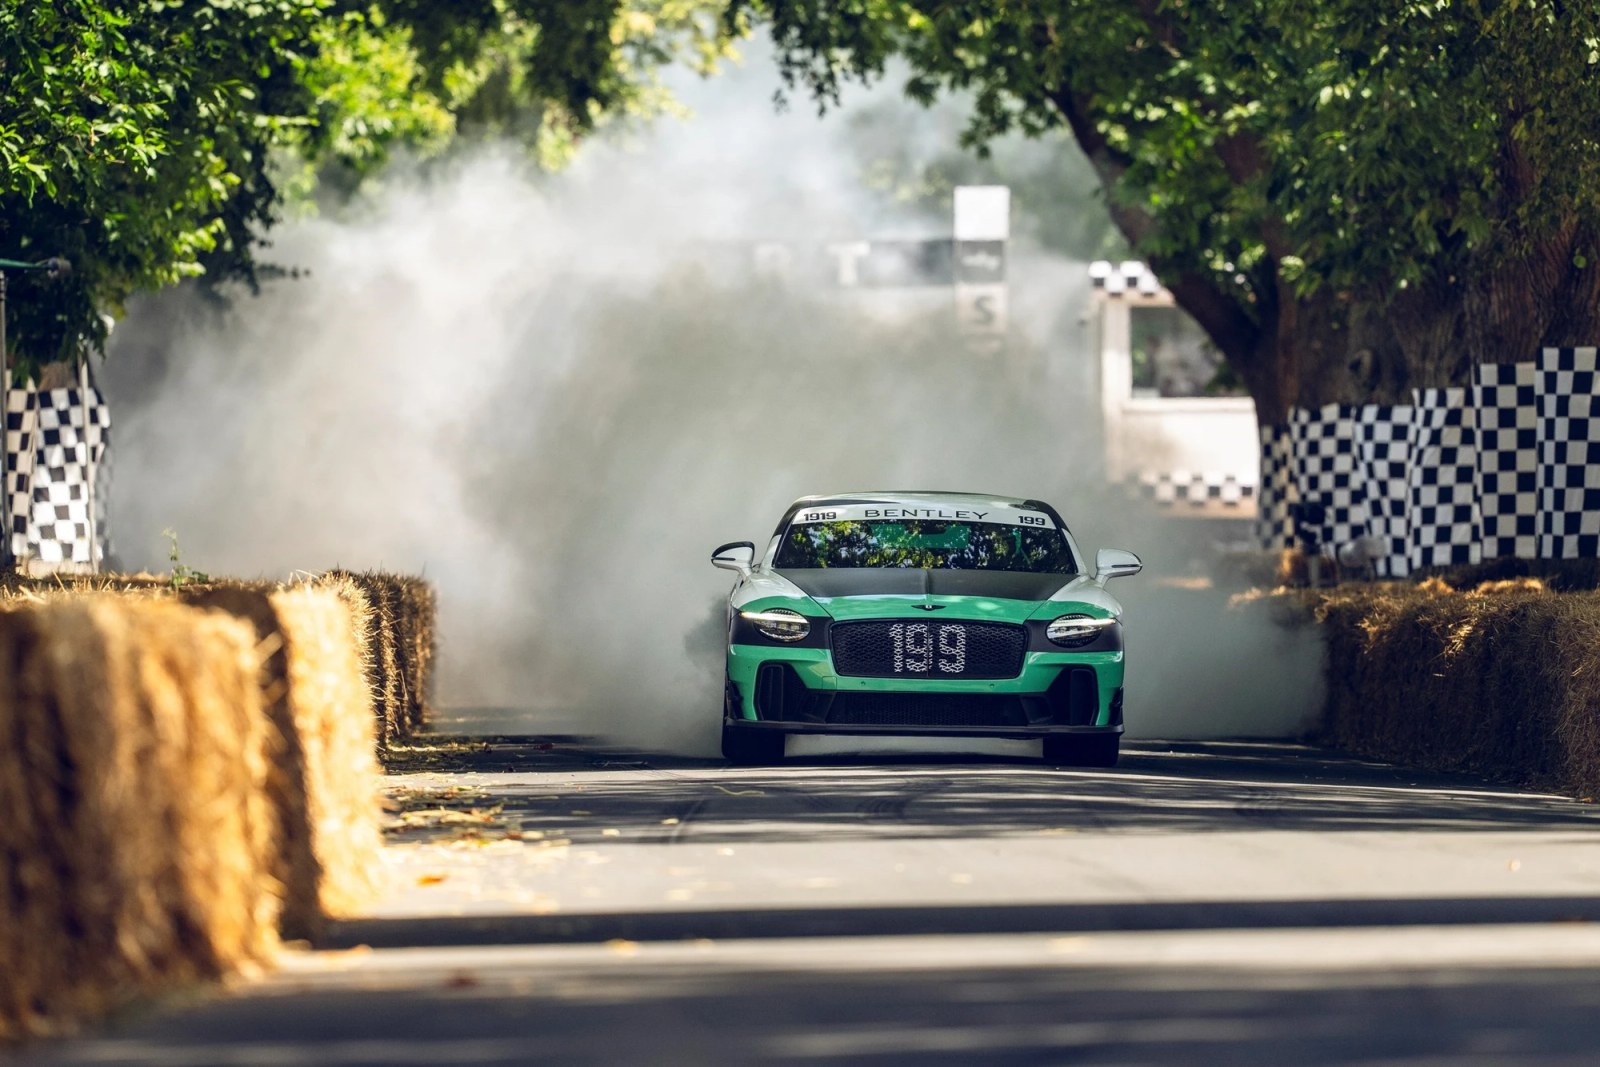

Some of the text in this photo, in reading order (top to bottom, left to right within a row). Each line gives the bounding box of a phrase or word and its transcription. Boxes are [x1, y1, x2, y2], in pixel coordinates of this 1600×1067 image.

[804, 509, 1046, 526] 1919 BENTLEY 199
[889, 623, 966, 673] 199
